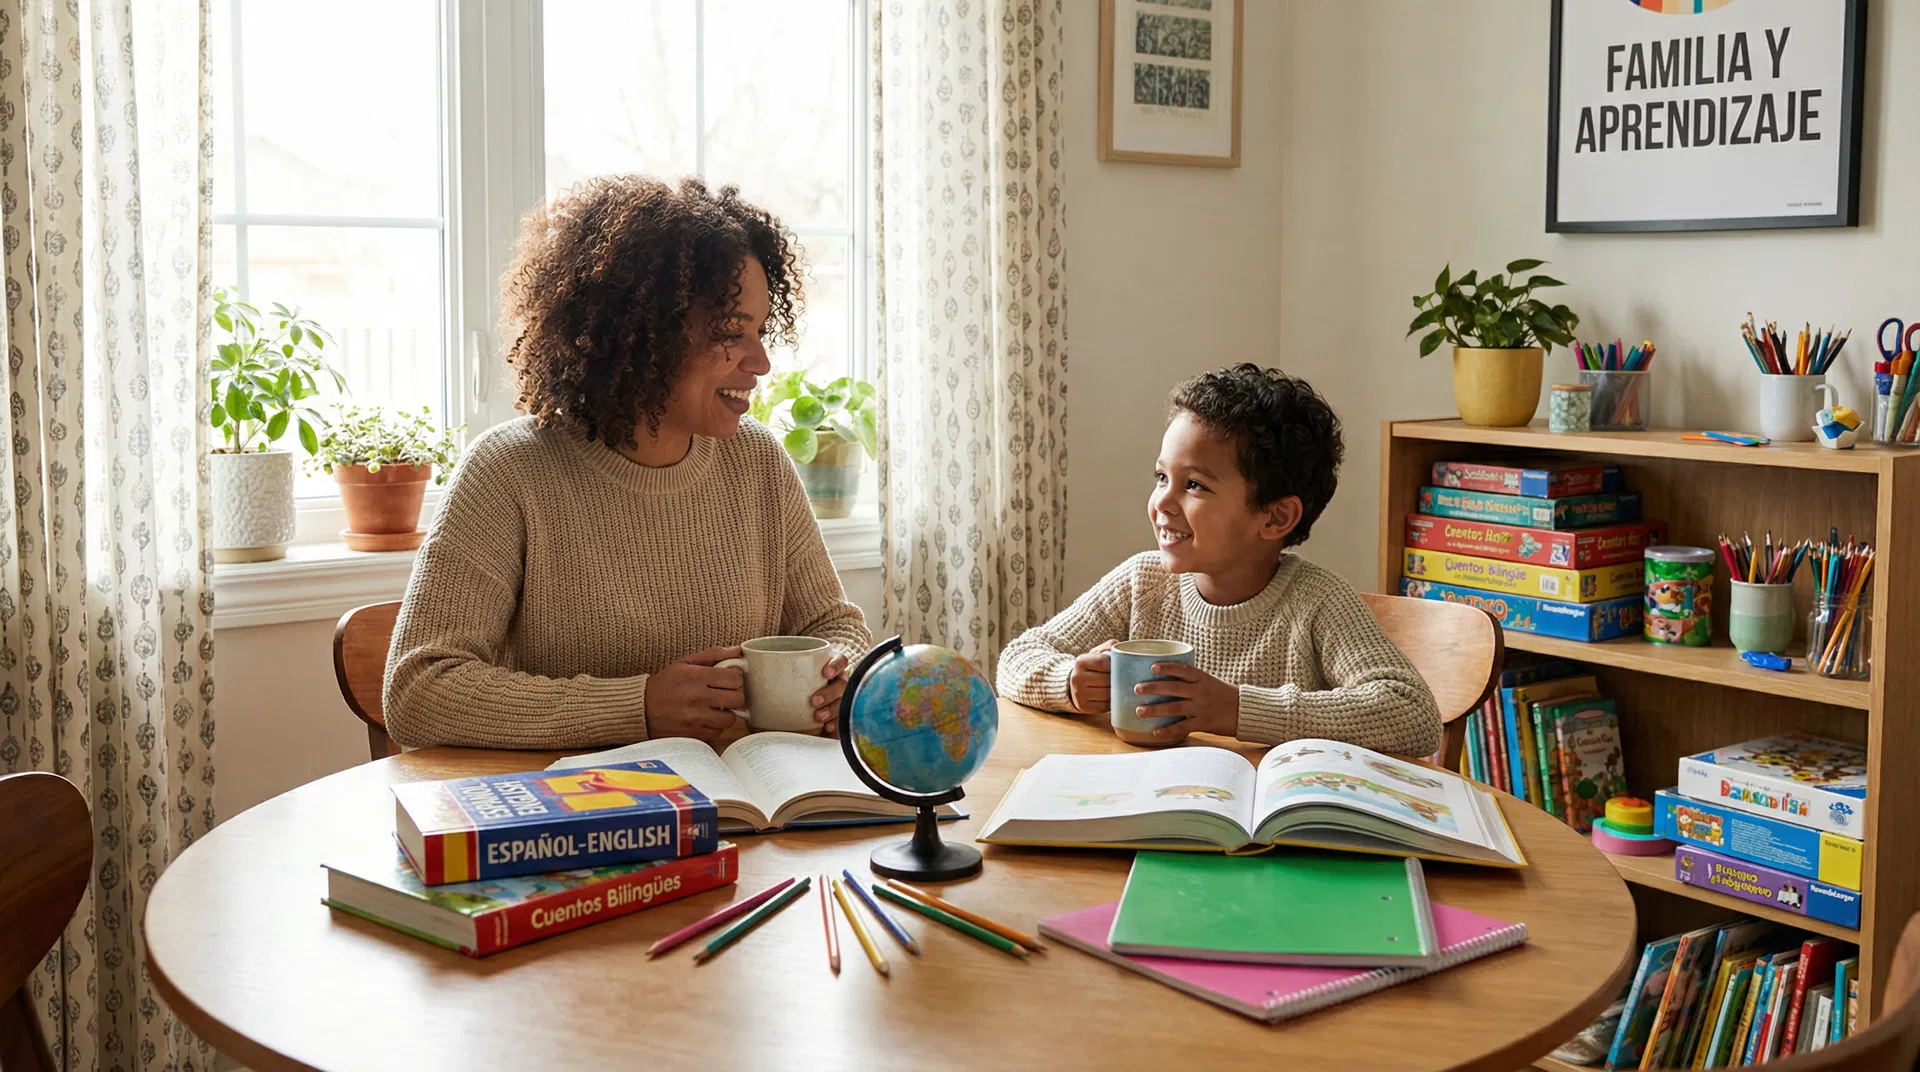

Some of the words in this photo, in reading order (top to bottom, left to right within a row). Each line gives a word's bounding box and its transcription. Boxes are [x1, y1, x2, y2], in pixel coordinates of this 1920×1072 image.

[1606, 31, 1753, 92] FAMILIA
[1765, 26, 1791, 78] Y
[1574, 88, 1823, 153] APRENDIZAJE
[1444, 557, 1484, 574] Cuentos
[492, 780, 550, 816] ENGLISH
[487, 824, 671, 865] ESPAÑOL-ENGLISH
[530, 897, 602, 930] Cuentos
[607, 873, 681, 909] Bilingües
